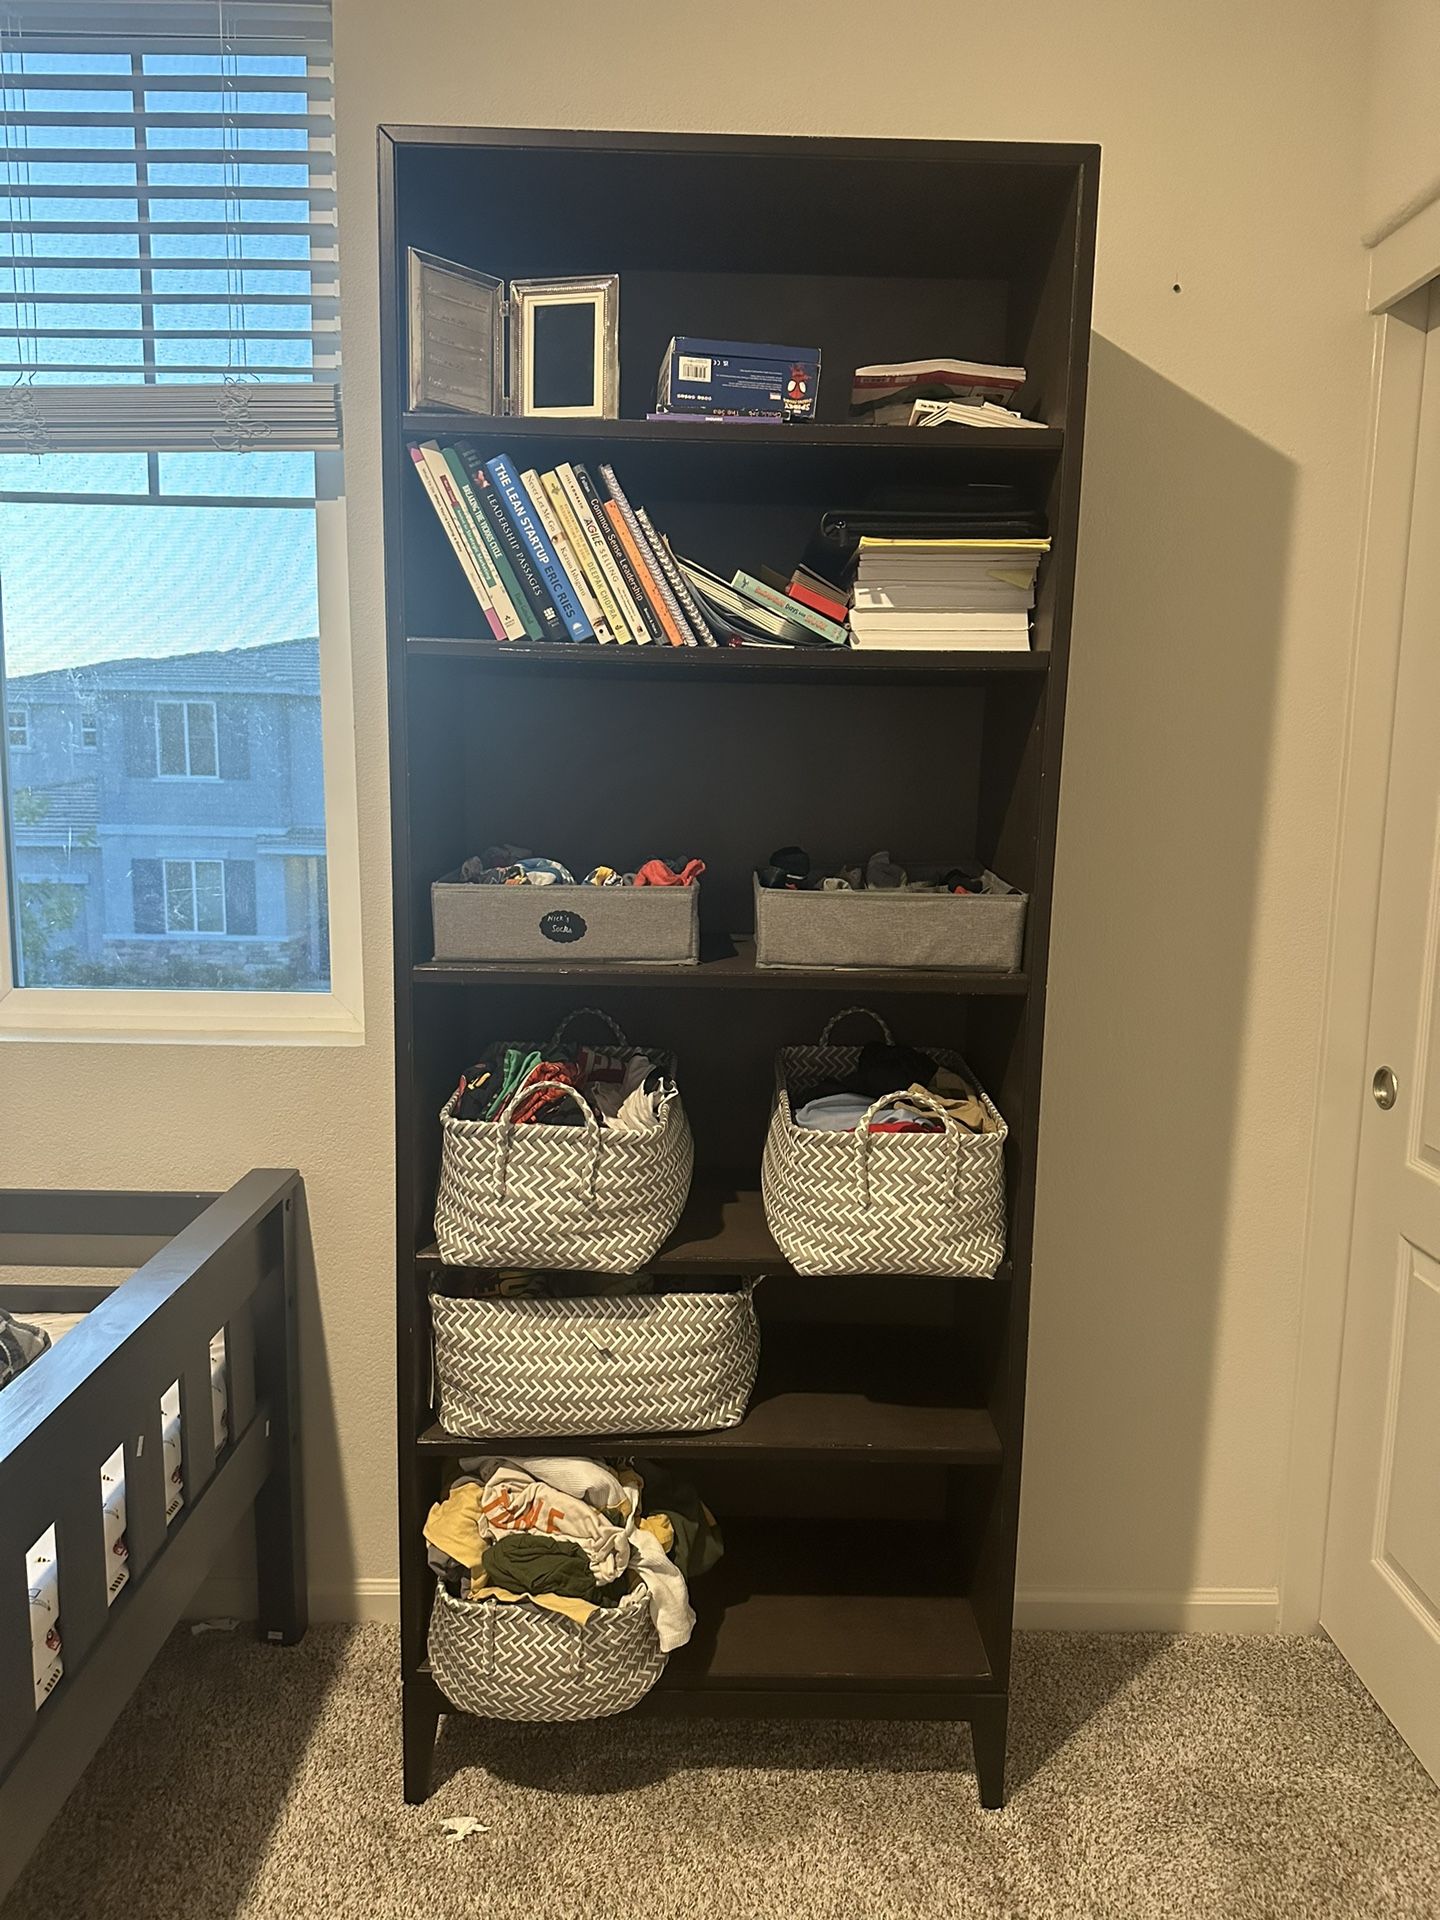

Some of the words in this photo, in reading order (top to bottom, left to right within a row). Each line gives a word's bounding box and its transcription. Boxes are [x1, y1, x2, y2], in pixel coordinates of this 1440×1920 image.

[461, 484, 480, 511] BREAKING
[474, 509, 485, 522] THE
[493, 462, 511, 486] THE
[504, 486, 526, 517] LEAN
[518, 515, 550, 565] STARTUP
[525, 474, 540, 495] Never
[536, 495, 546, 508] Let
[547, 519, 557, 532] Go
[464, 528, 480, 553] Strategic
[474, 552, 492, 580] Marketing
[478, 520, 495, 542] VICIOUS
[485, 493, 521, 551] LEADERSHIP
[514, 551, 543, 596] PASSAGES
[488, 540, 503, 559] CYCLE
[581, 515, 605, 548] AGILE
[597, 547, 621, 583] SELLING
[589, 497, 612, 533] Common
[606, 532, 624, 558] Sense
[617, 557, 645, 602] Leadership
[543, 565, 563, 592] ERIC
[556, 591, 576, 618] RIES
[559, 546, 575, 569] Kazuo
[569, 568, 587, 597] Ishiguro
[585, 561, 604, 589] DEEPAK
[598, 589, 618, 619] CHOPRA
